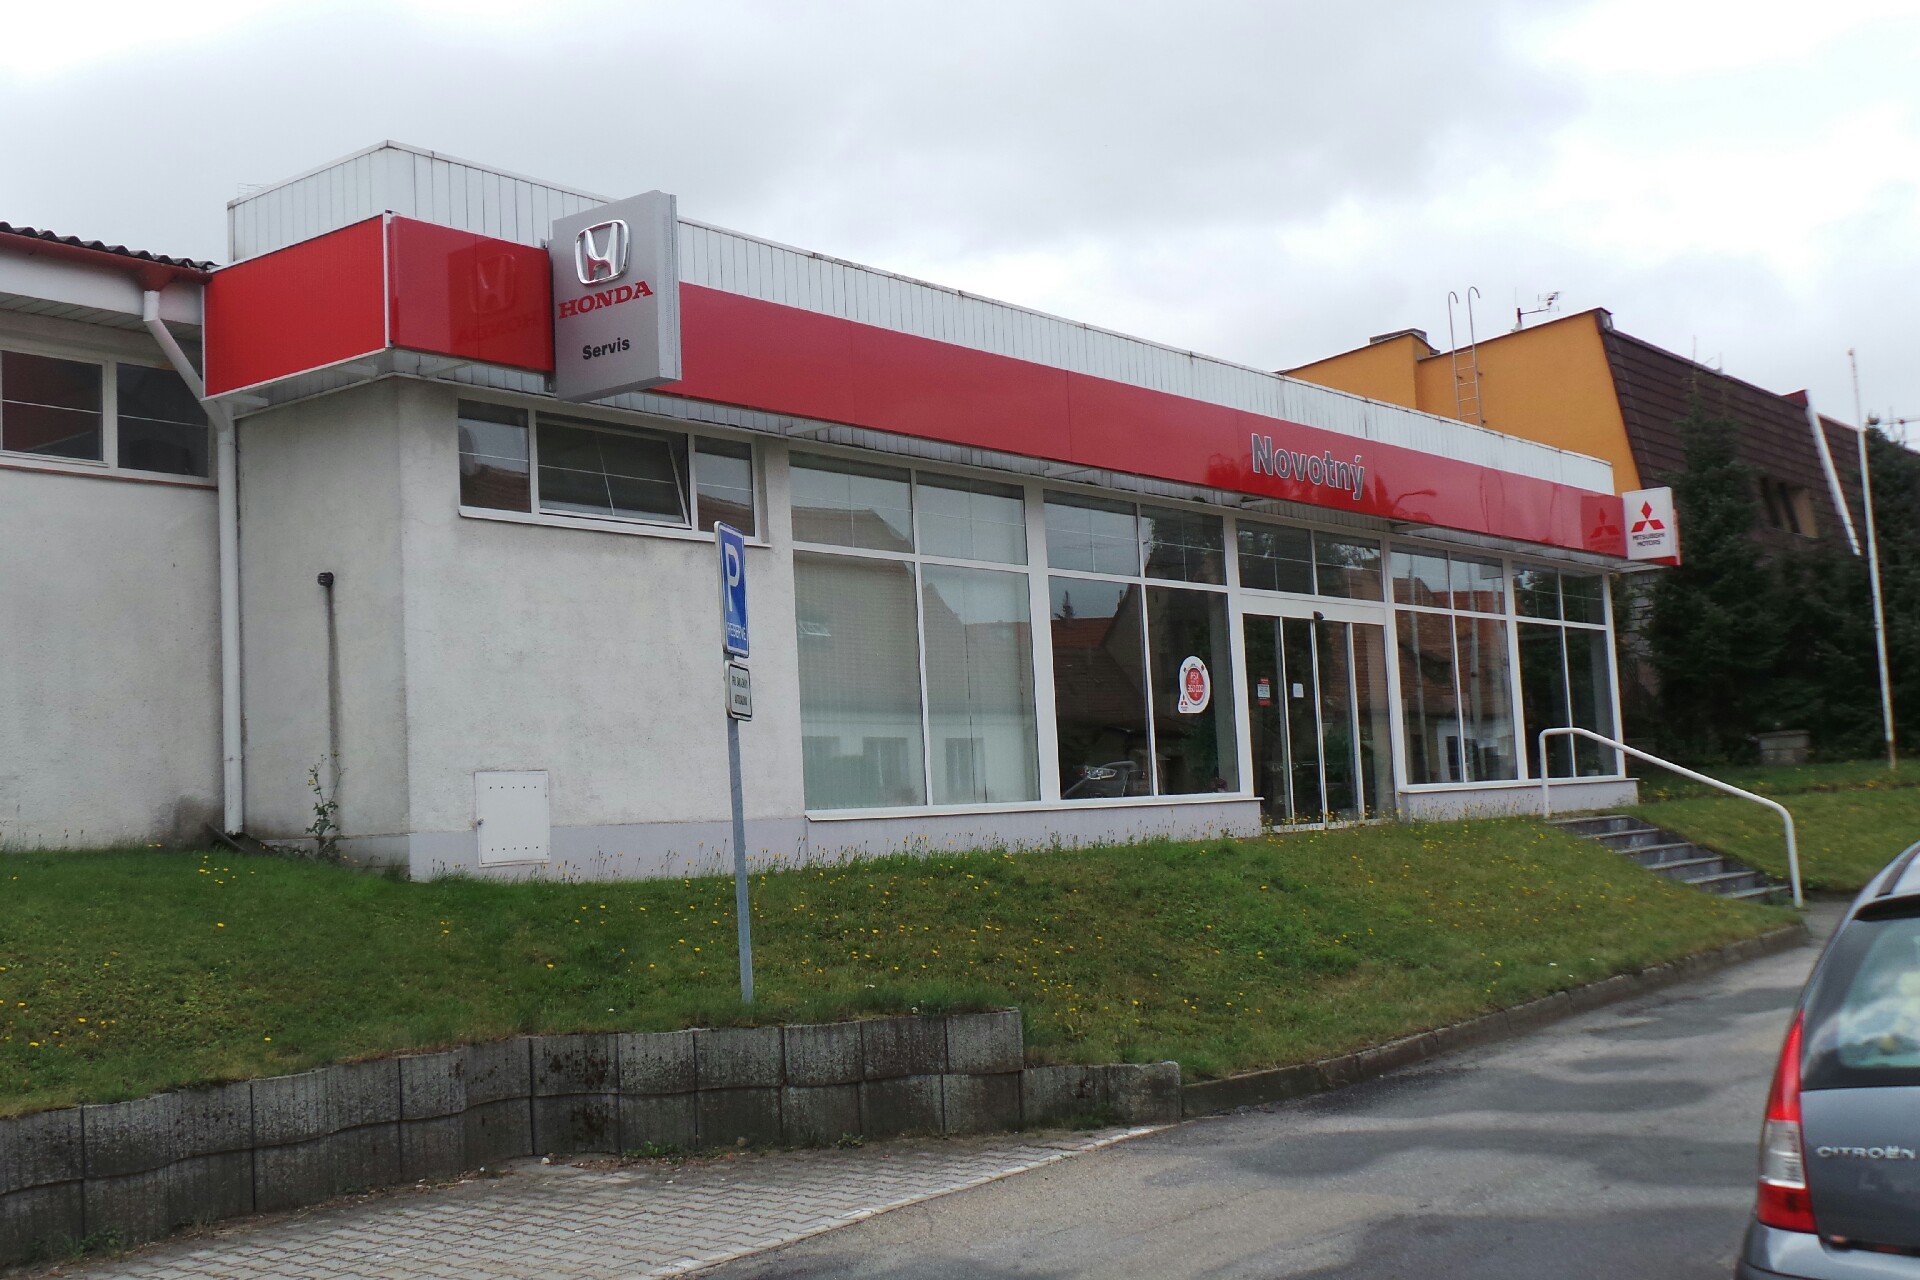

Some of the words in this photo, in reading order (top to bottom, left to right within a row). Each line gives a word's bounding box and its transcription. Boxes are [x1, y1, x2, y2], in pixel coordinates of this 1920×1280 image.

[557, 280, 654, 319] HONDA
[582, 337, 631, 361] Servis
[1251, 432, 1365, 501] Novotný
[724, 542, 740, 612] P
